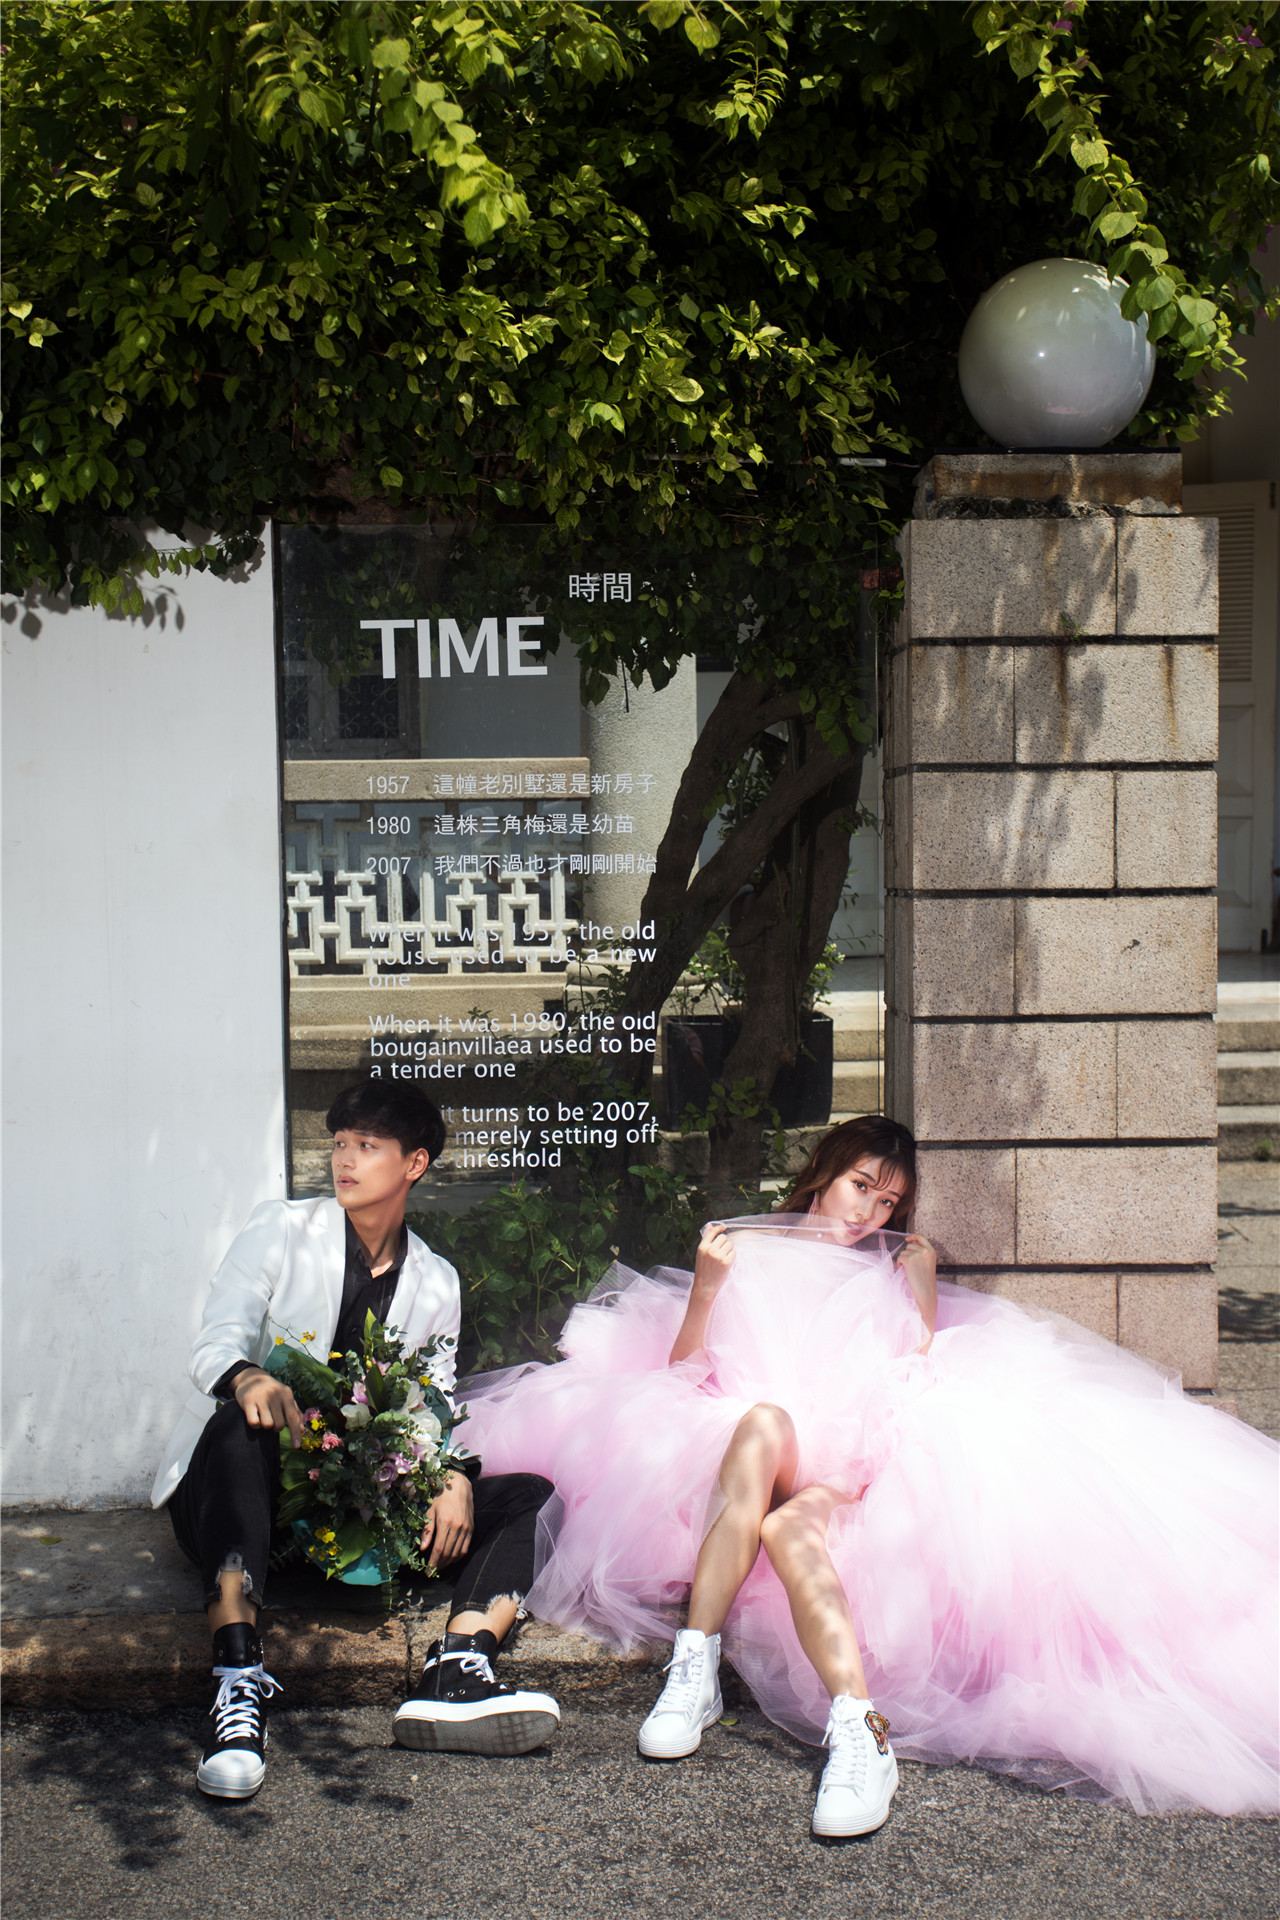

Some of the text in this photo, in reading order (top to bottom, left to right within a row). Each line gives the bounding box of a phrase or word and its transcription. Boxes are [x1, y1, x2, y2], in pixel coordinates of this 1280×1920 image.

[568, 572, 632, 603] 時間
[360, 616, 547, 679] TIME
[366, 773, 657, 795] 1957 這幢老別墅還是新房子
[366, 813, 635, 836] 1980 這株三角梅還是幼苗
[366, 853, 657, 875] 2007 我們不過也才剛剛開始
[368, 922, 429, 942] When
[437, 922, 451, 942] it
[458, 926, 500, 942] was
[579, 920, 614, 940] the
[621, 919, 656, 940] old
[369, 943, 657, 965] house used to be a new
[369, 973, 411, 989] one
[369, 1014, 430, 1034] When
[438, 1014, 452, 1033] it
[458, 1017, 500, 1033] was
[510, 1012, 573, 1035] 1980,
[580, 1010, 615, 1031] the
[370, 1033, 656, 1060] bougainvillaea used to be
[370, 1059, 516, 1079] a tender one
[441, 1101, 657, 1125] it turns to be 2007,
[455, 1123, 659, 1149] merely setting off
[455, 1147, 562, 1168] threshold
